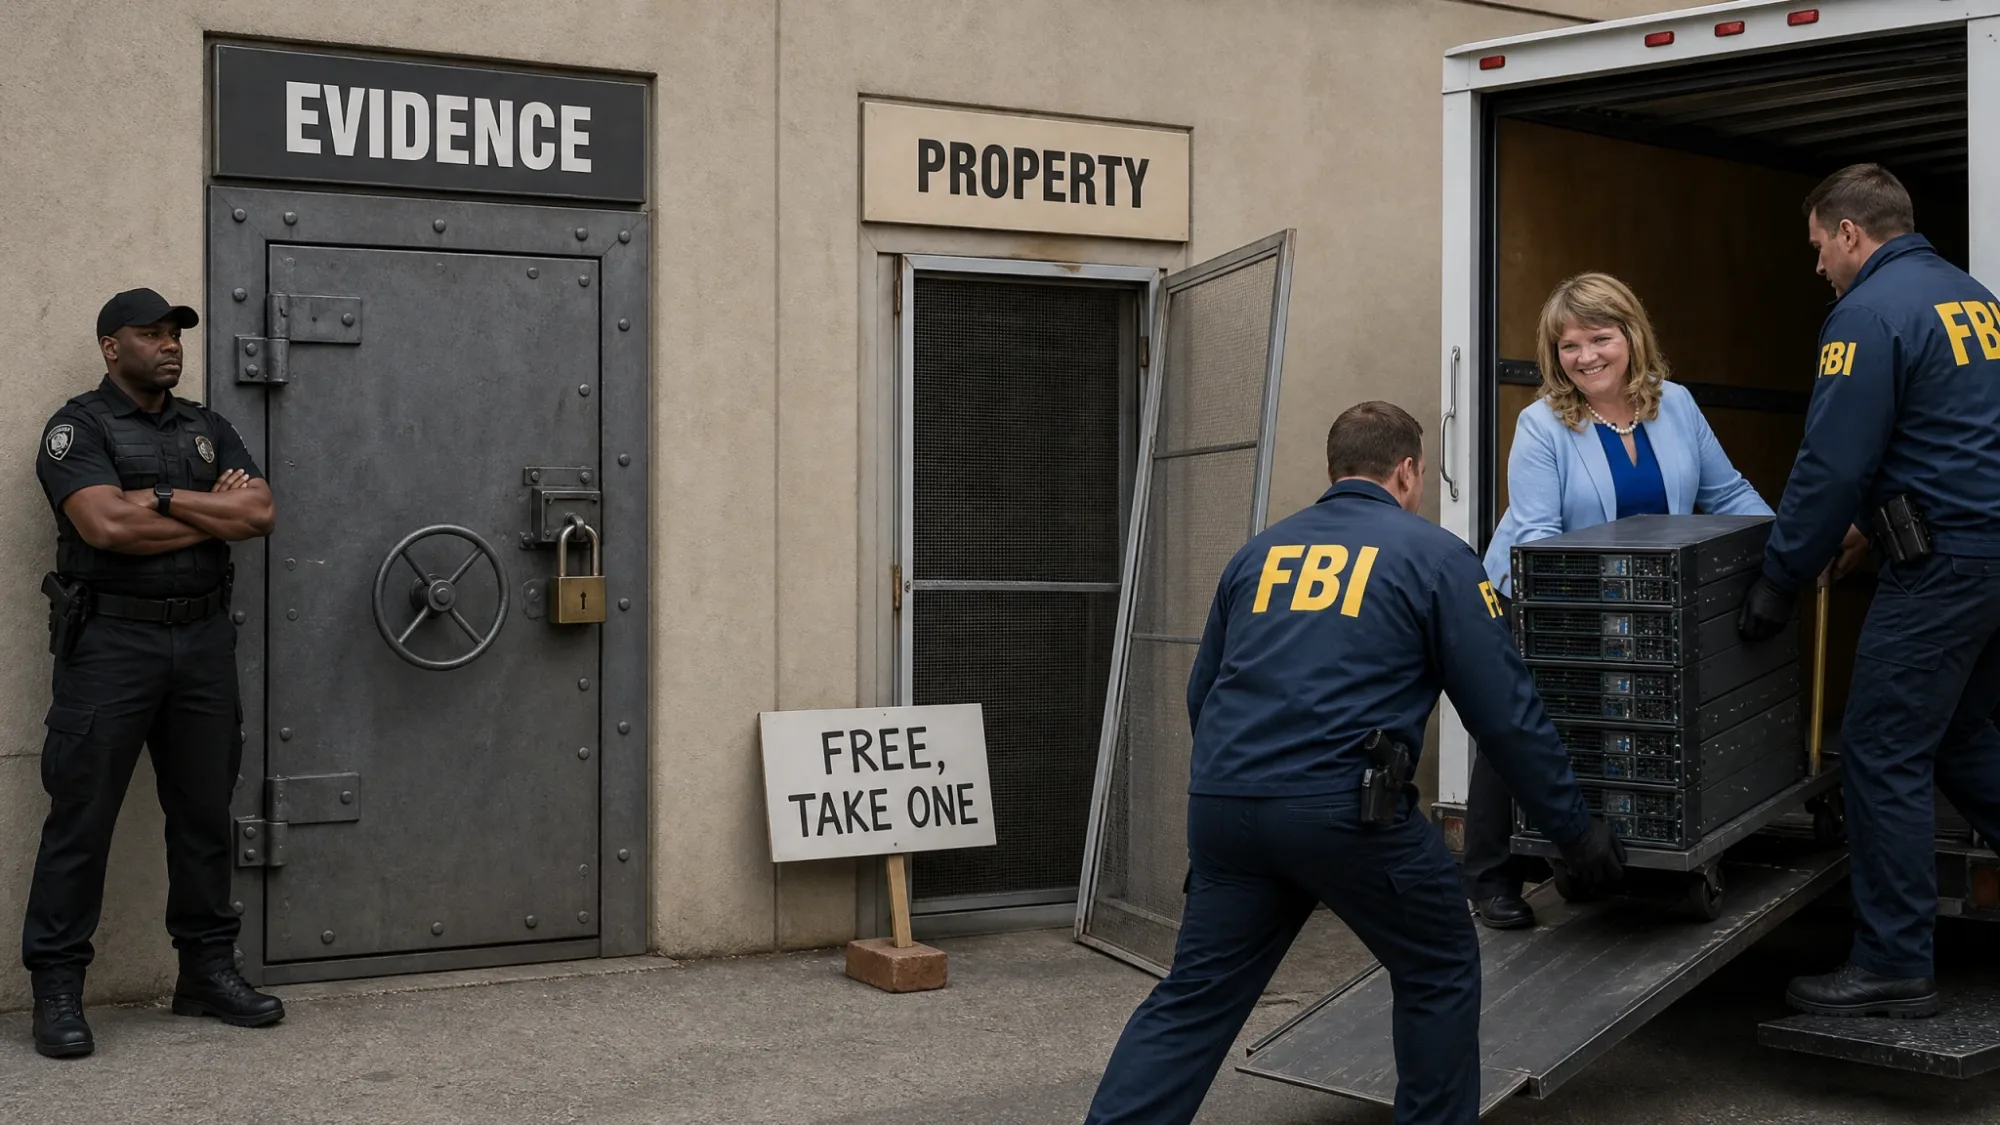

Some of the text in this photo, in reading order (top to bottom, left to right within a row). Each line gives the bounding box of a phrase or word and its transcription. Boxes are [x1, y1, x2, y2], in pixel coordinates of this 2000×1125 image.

[285, 80, 593, 173] EVIDENCE
[917, 138, 1150, 209] PROPERTY
[1817, 341, 1858, 378] FBI
[1934, 300, 2000, 366] FB
[1252, 544, 1379, 617] FBI
[821, 726, 946, 776] FREE,
[787, 782, 979, 838] TAKE ONE
